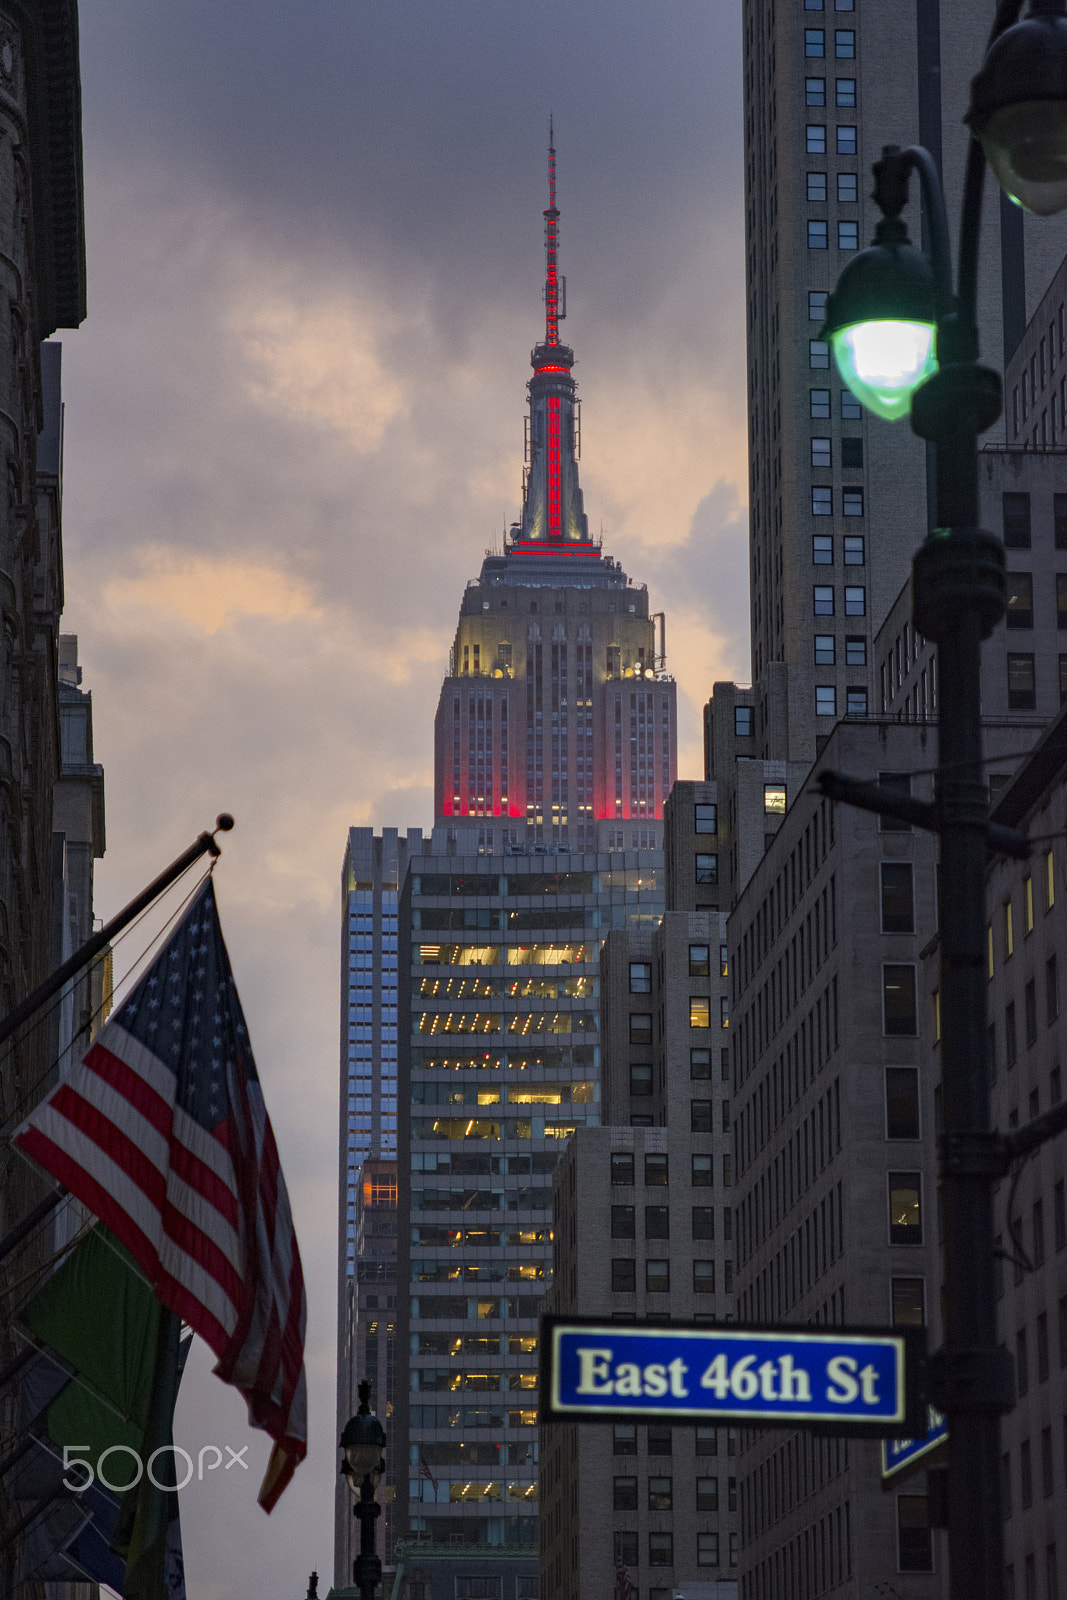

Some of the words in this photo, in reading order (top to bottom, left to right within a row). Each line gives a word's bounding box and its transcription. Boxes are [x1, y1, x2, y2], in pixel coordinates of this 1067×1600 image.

[576, 1348, 688, 1398] East
[700, 1353, 812, 1403] 46th
[826, 1355, 880, 1405] St
